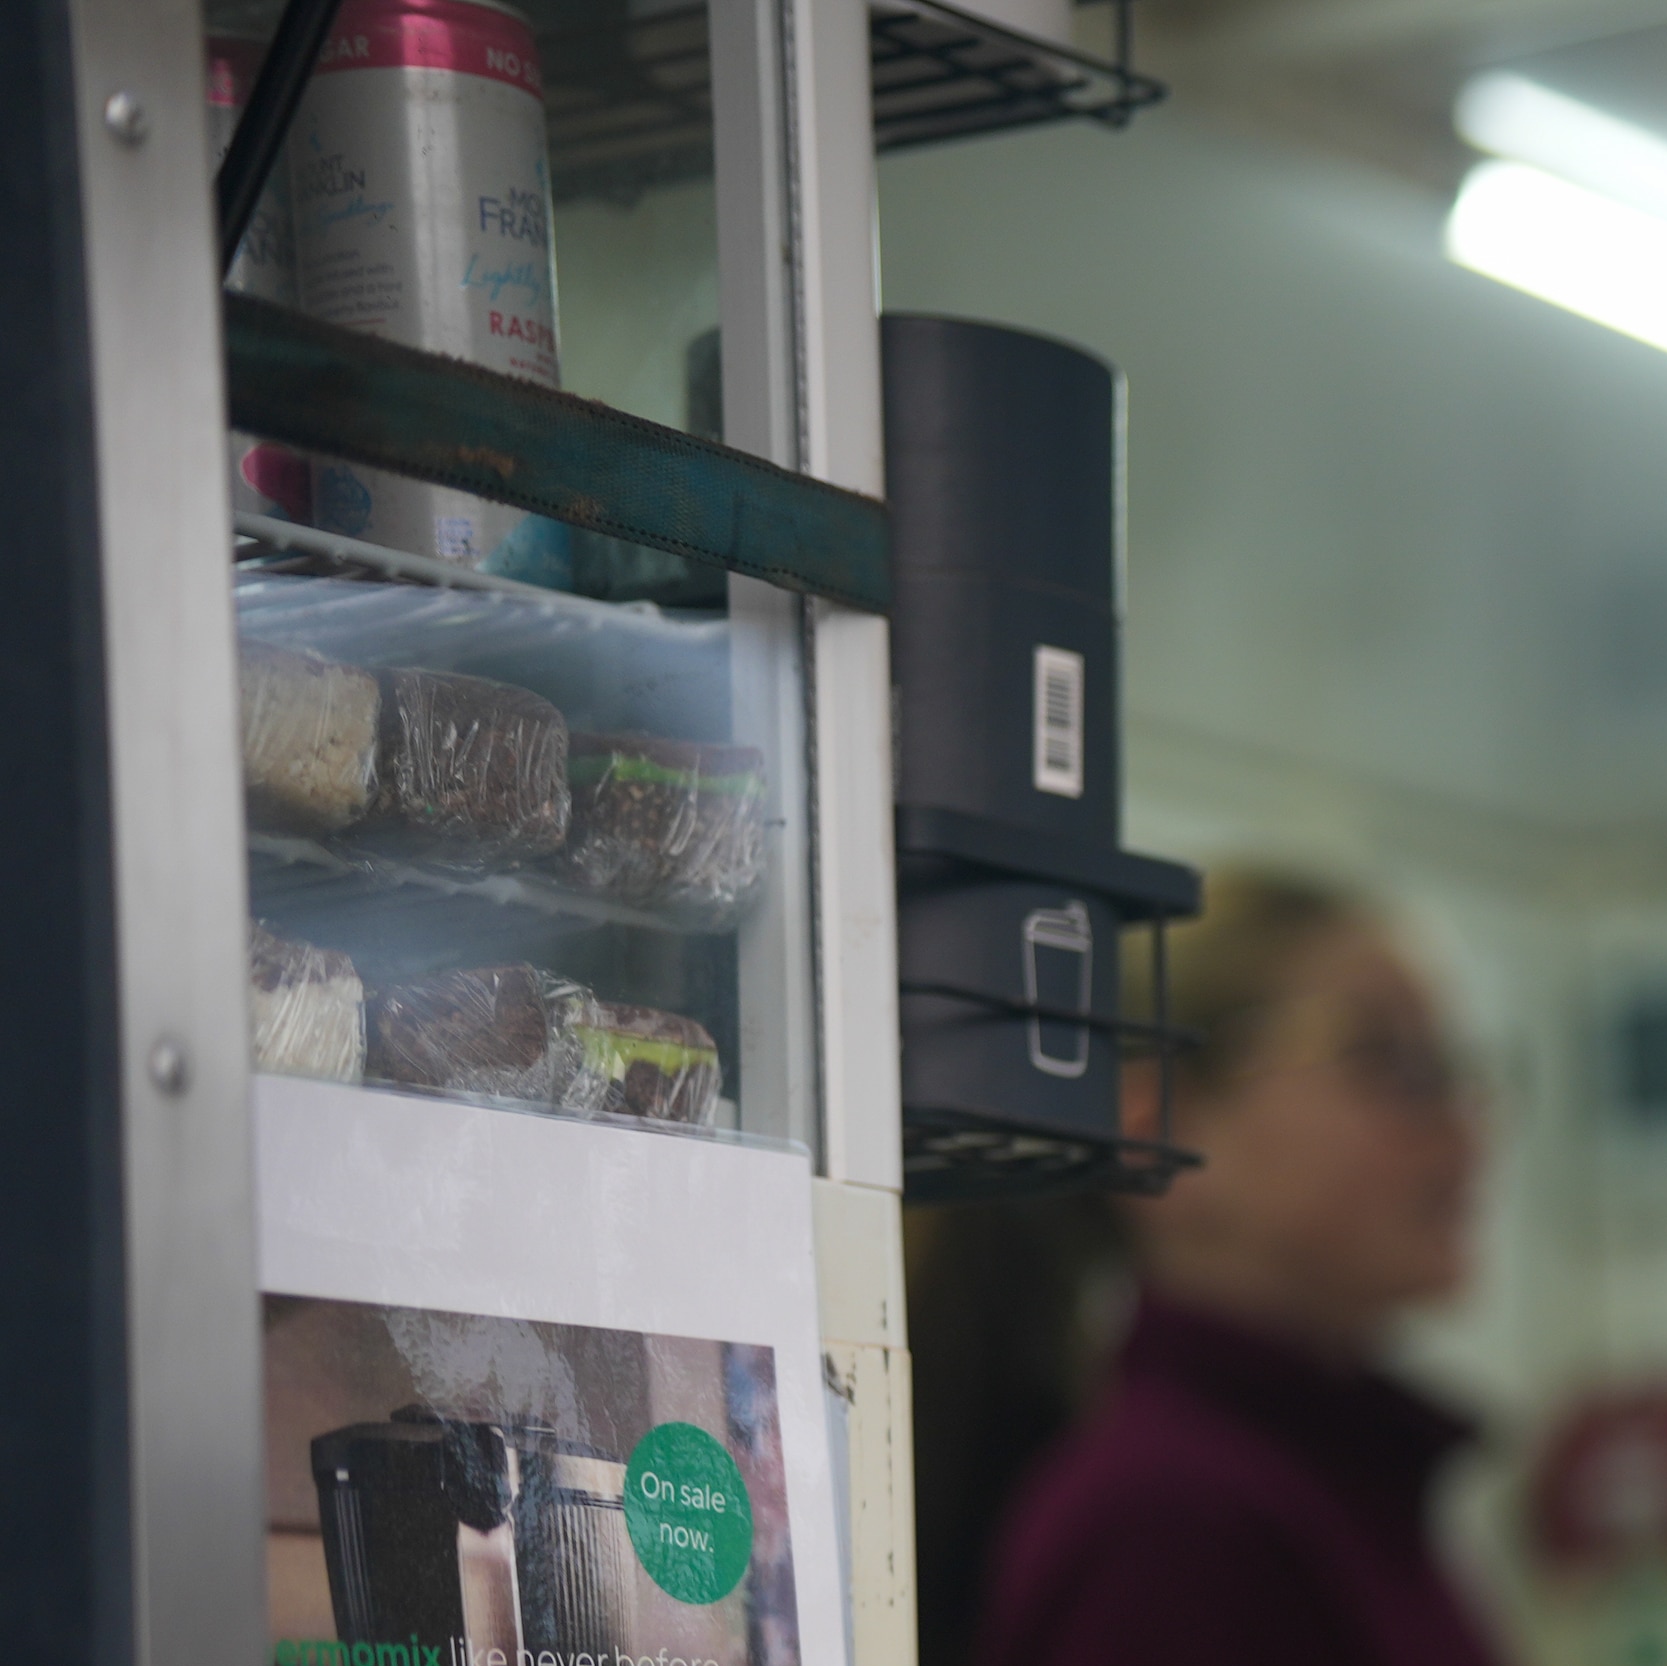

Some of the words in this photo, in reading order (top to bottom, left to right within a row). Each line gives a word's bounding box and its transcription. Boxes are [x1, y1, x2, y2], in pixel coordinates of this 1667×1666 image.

[486, 46, 522, 78] NO
[640, 1471, 675, 1502] On
[680, 1483, 726, 1514] sale
[659, 1522, 715, 1553] now.
